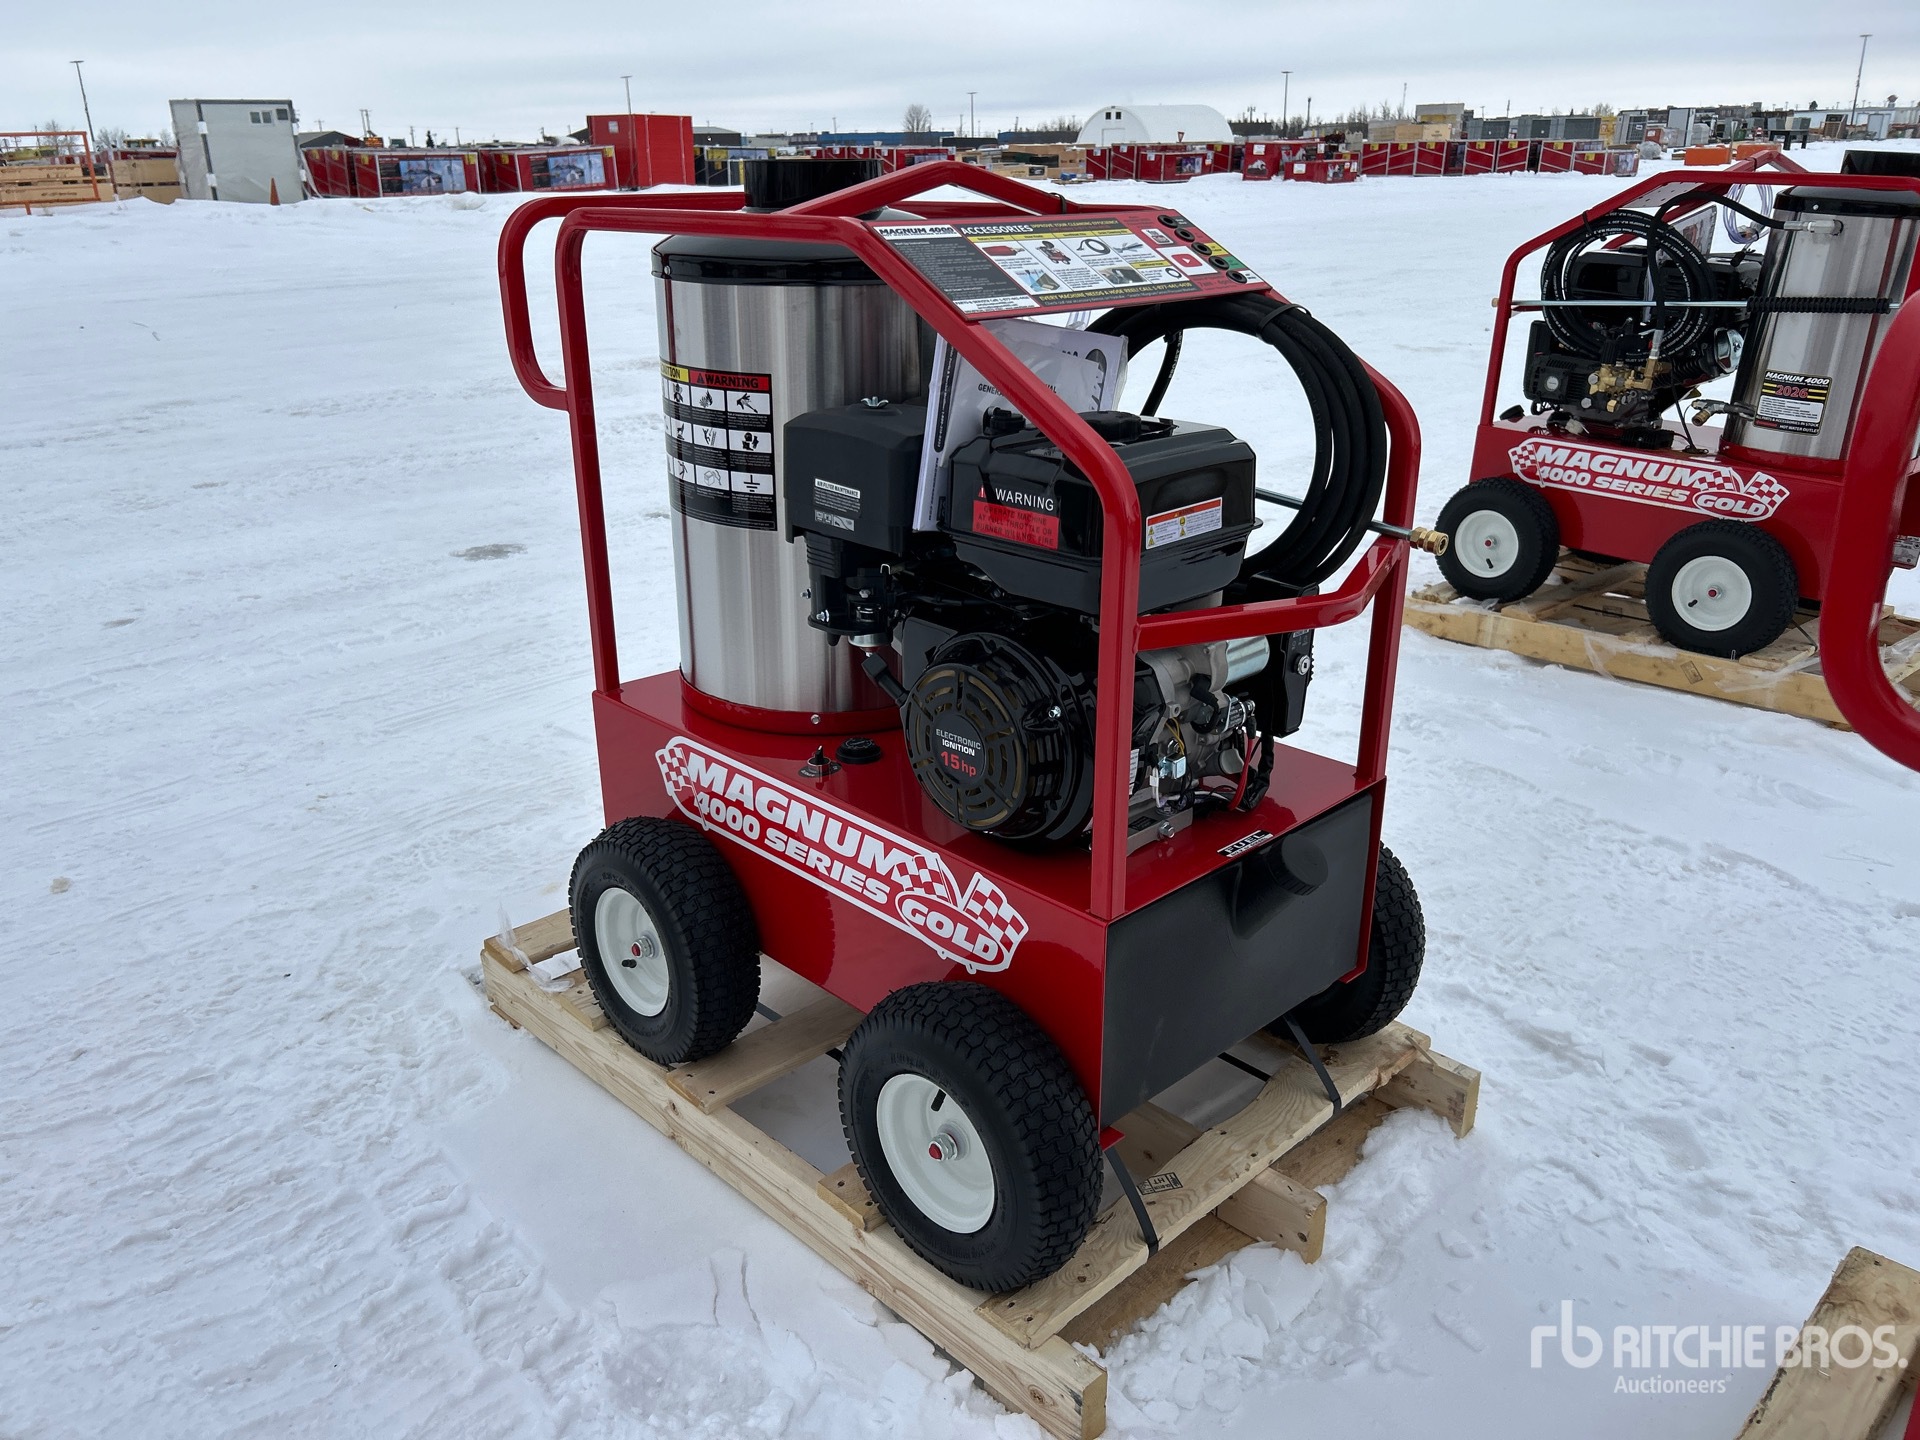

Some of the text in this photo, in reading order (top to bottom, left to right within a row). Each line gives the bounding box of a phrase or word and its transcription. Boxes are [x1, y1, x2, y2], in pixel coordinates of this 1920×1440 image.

[878, 226, 956, 235] MAGNUM 4000
[960, 224, 1034, 235] ACCESSORIES
[1057, 292, 1086, 300] MACHINE
[705, 374, 759, 389] WARNING
[1765, 371, 1830, 385] MAGNUM 4000
[1775, 384, 1809, 399] 2026
[1535, 445, 1706, 490] MAGNUM
[1536, 466, 1691, 502] 4000 SERIES
[995, 488, 1054, 511] WARNING
[1696, 492, 1768, 516] GOLD
[983, 505, 1047, 525] OPERATE MACHINE
[989, 515, 1004, 526] FULL
[1005, 519, 1040, 534] THROTTLE
[1043, 527, 1052, 535] OR
[976, 522, 1003, 535] BURNER
[1038, 535, 1054, 546] FIRE
[935, 728, 981, 750] ELECTRONIC
[942, 738, 976, 757] IGNITION
[686, 751, 906, 884] MAGNUM
[693, 790, 892, 905] 4000 SERIES
[1224, 834, 1266, 854] FUEL
[900, 899, 999, 963] GOLD
[1153, 1177, 1166, 1185] HT
